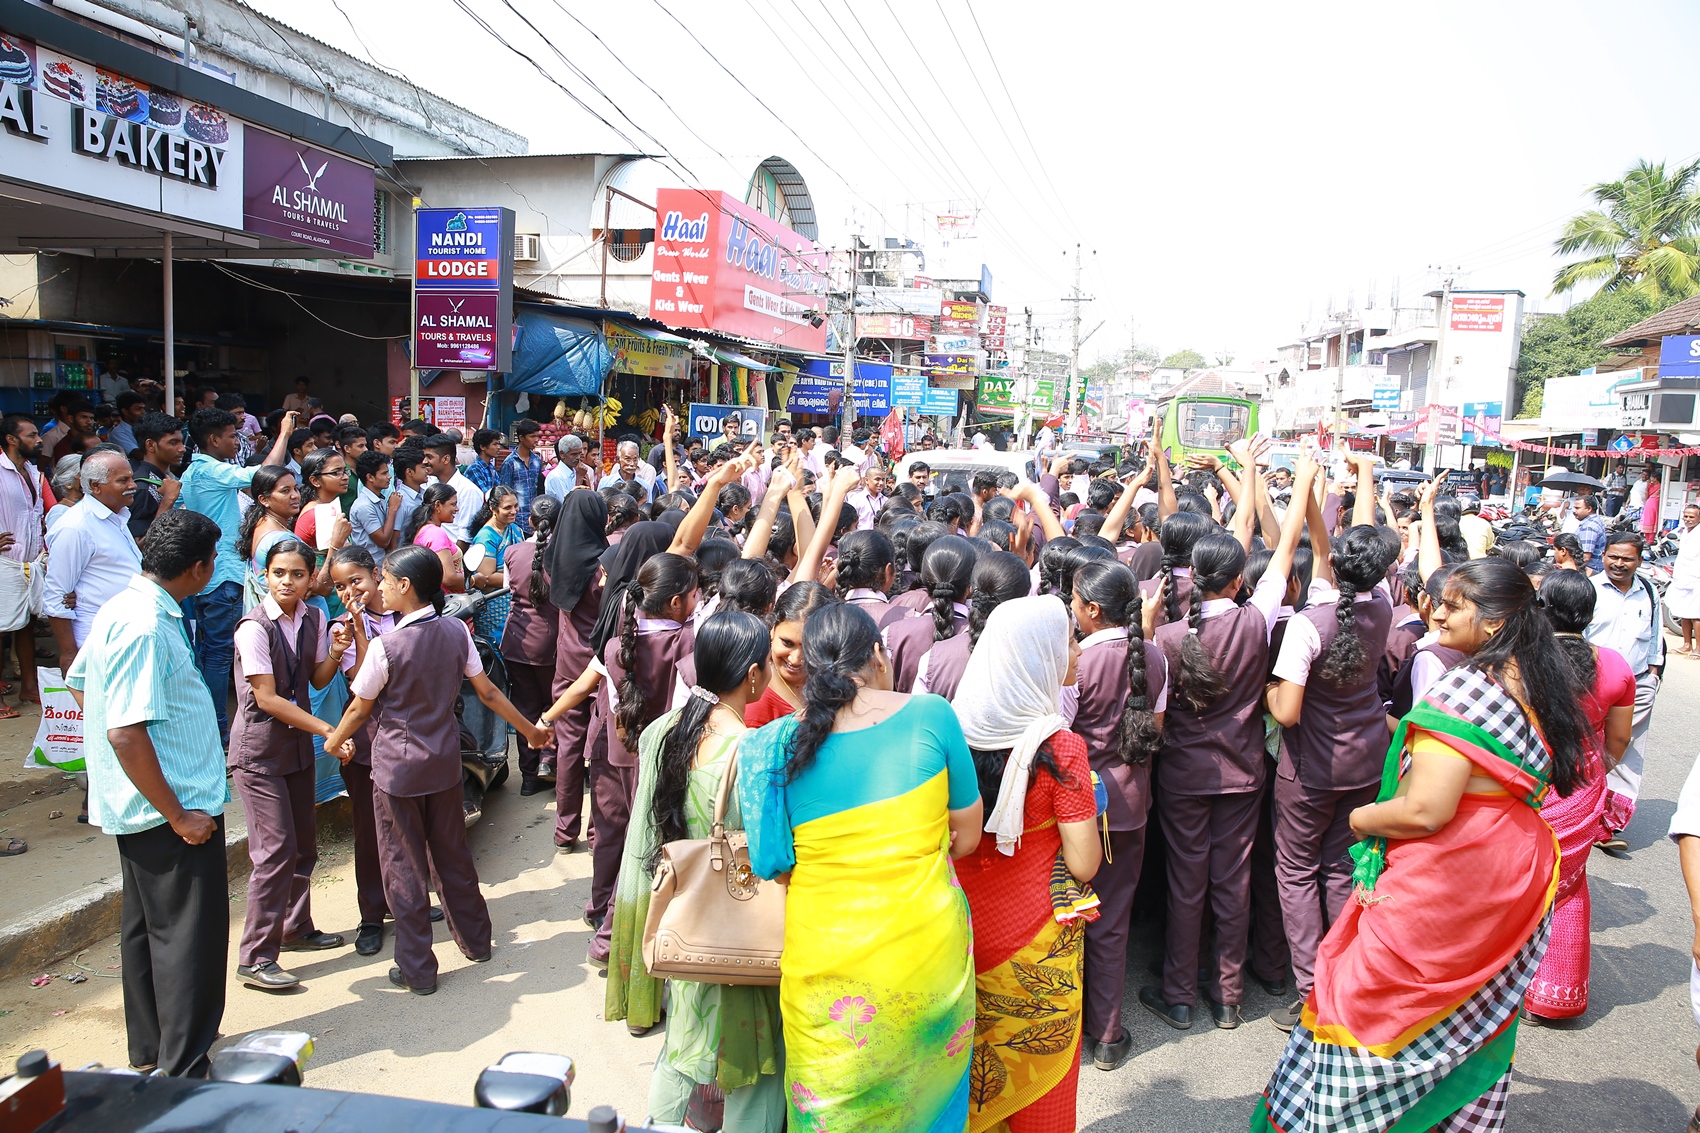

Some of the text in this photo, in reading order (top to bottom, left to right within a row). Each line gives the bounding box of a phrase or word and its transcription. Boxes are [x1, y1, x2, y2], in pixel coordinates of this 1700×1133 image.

[84, 108, 228, 187] BAKERY
[272, 185, 348, 223] AL SHAMAL
[283, 210, 340, 231] TOURS & TRAVELS
[662, 211, 709, 243] Haai
[431, 232, 483, 246] NANDI
[428, 247, 487, 255] TOURIST HOME
[657, 246, 710, 258] Dress World
[726, 213, 780, 282] Haai
[428, 261, 488, 277] LODGE
[653, 270, 709, 284] Gents Wear
[675, 285, 684, 298] &
[655, 299, 704, 313] Kids Wear
[749, 290, 764, 309] Gents
[765, 295, 779, 313] Wear
[420, 314, 493, 328] AL SHAMAL
[889, 317, 915, 338] 50
[420, 332, 492, 342] TOURS & TRAVELS
[652, 340, 669, 357] Fresh
[669, 345, 684, 359] Juice
[862, 377, 878, 389] (CBE)
[983, 381, 1016, 393] DAY
